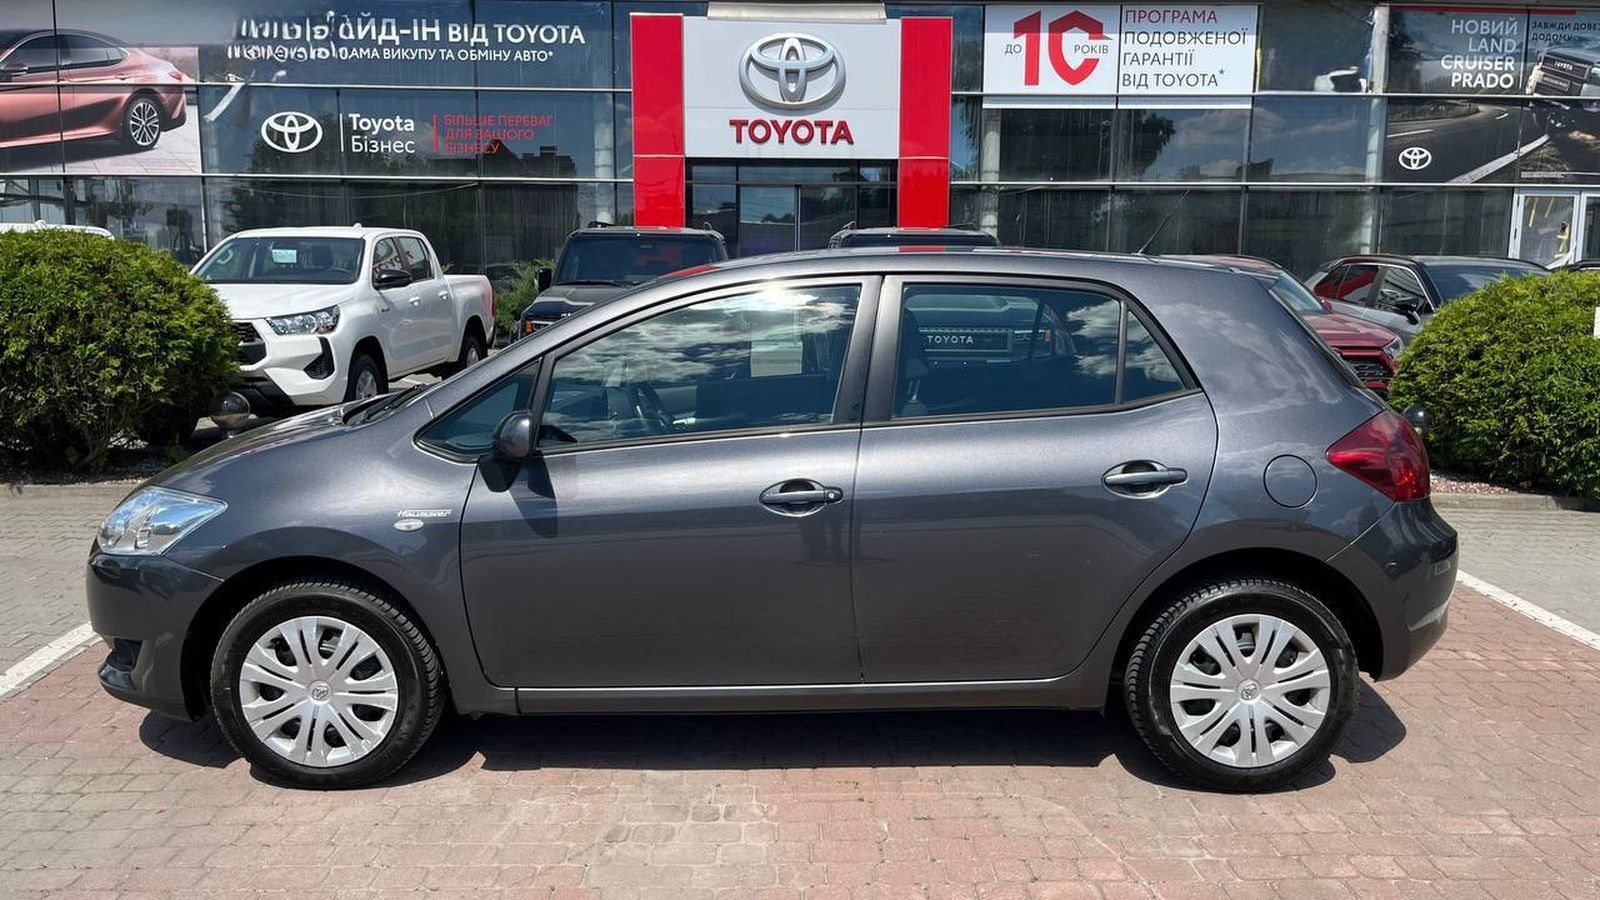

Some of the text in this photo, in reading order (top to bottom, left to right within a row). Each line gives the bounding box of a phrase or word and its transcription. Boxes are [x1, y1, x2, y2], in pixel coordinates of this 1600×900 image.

[1125, 9, 1218, 24] ПРОГРАМА
[1451, 17, 1518, 35] НОВИЙ
[448, 23, 489, 47] ВІД
[493, 24, 586, 44] TOYOTA
[1124, 27, 1248, 47] ПОДОВЖЕНОЇ
[1004, 44, 1022, 55] ДО
[1074, 44, 1109, 55] РОКІВ
[1468, 37, 1517, 53] LAND
[383, 48, 436, 61] ВИКУПУ
[438, 49, 455, 61] ТА
[457, 49, 511, 62] ОБМІНУ
[1123, 48, 1195, 66] ГАРАНТІЇ
[1441, 54, 1515, 71] CRUISER
[1122, 73, 1149, 90] ВІД
[1451, 72, 1514, 89] PRADO
[348, 113, 415, 135] Toyota
[729, 119, 855, 145] TOYOTA
[351, 135, 416, 154] Бізнес
[927, 335, 974, 344] TOYOTA
